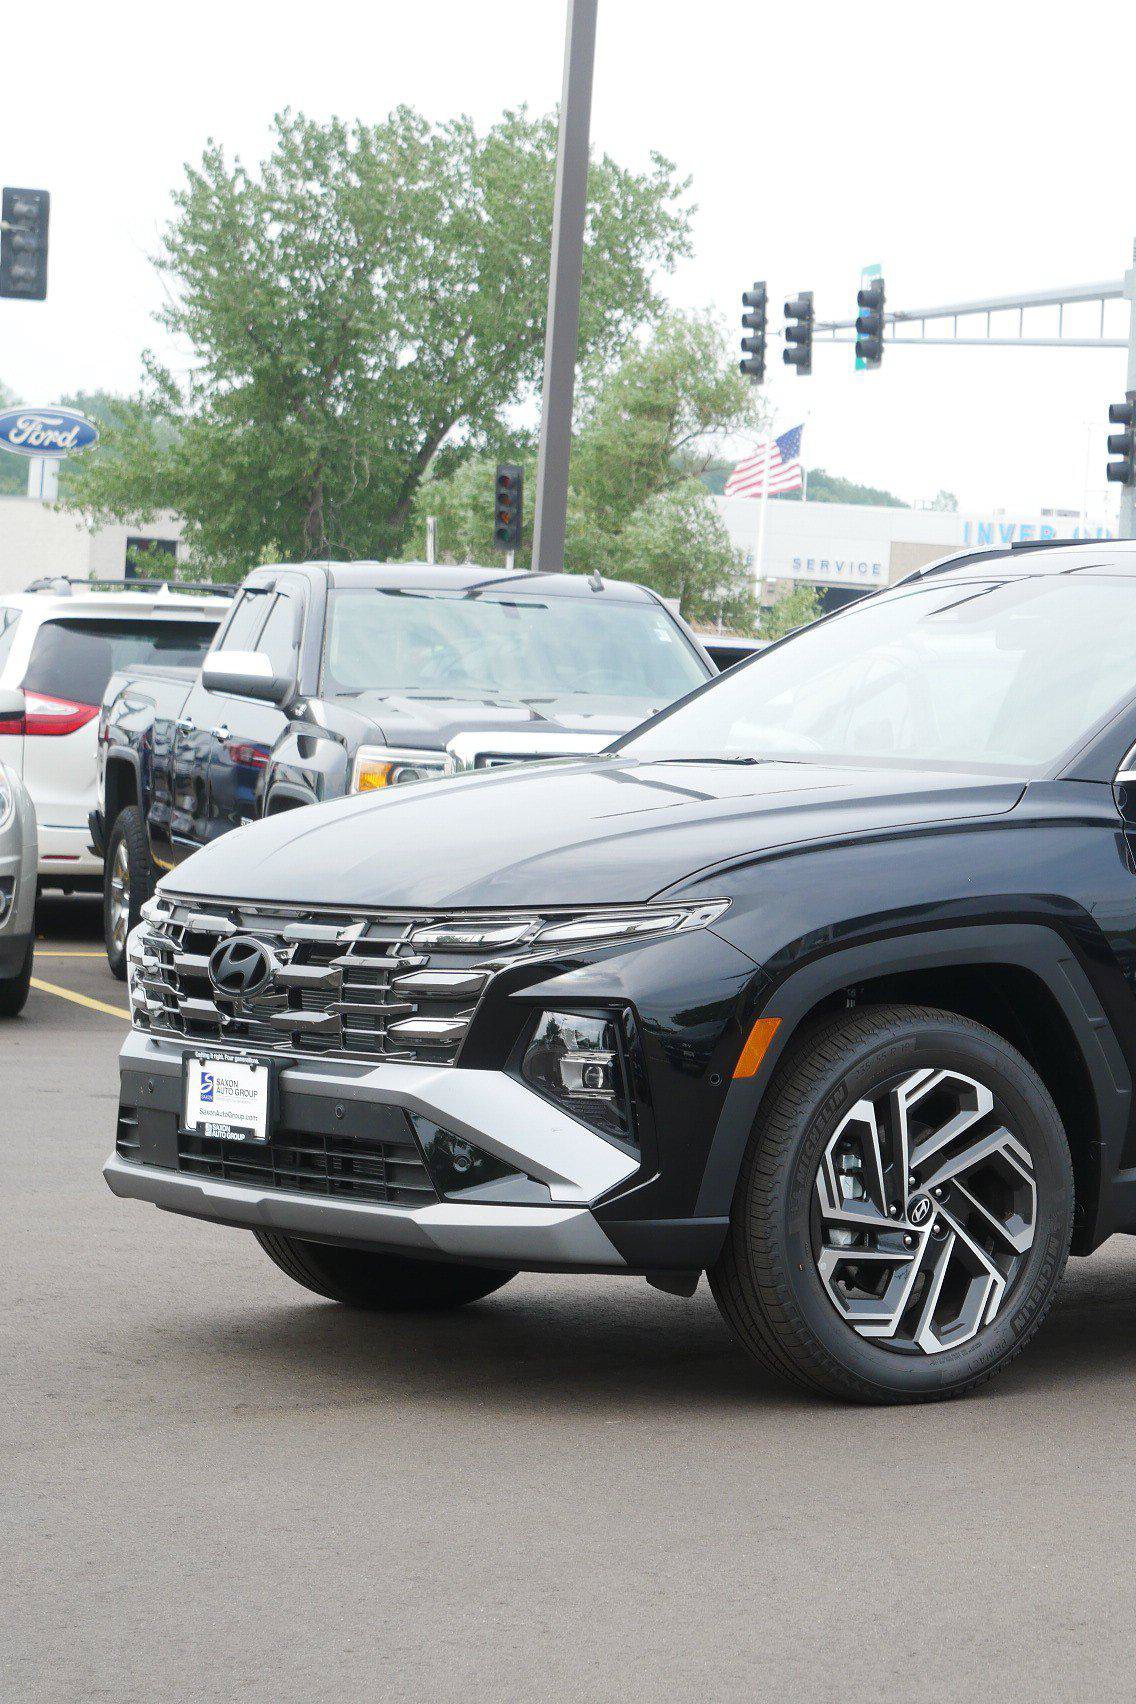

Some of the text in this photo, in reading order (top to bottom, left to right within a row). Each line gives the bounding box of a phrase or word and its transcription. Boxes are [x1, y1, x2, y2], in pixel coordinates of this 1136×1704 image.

[8, 415, 80, 447] Ford
[792, 558, 881, 576] SERVICE
[216, 1078, 239, 1088] SAXON
[216, 1086, 259, 1098] AUTO GROUP
[212, 1124, 231, 1133] SAXON
[212, 1130, 246, 1140] AUTO GROUP
